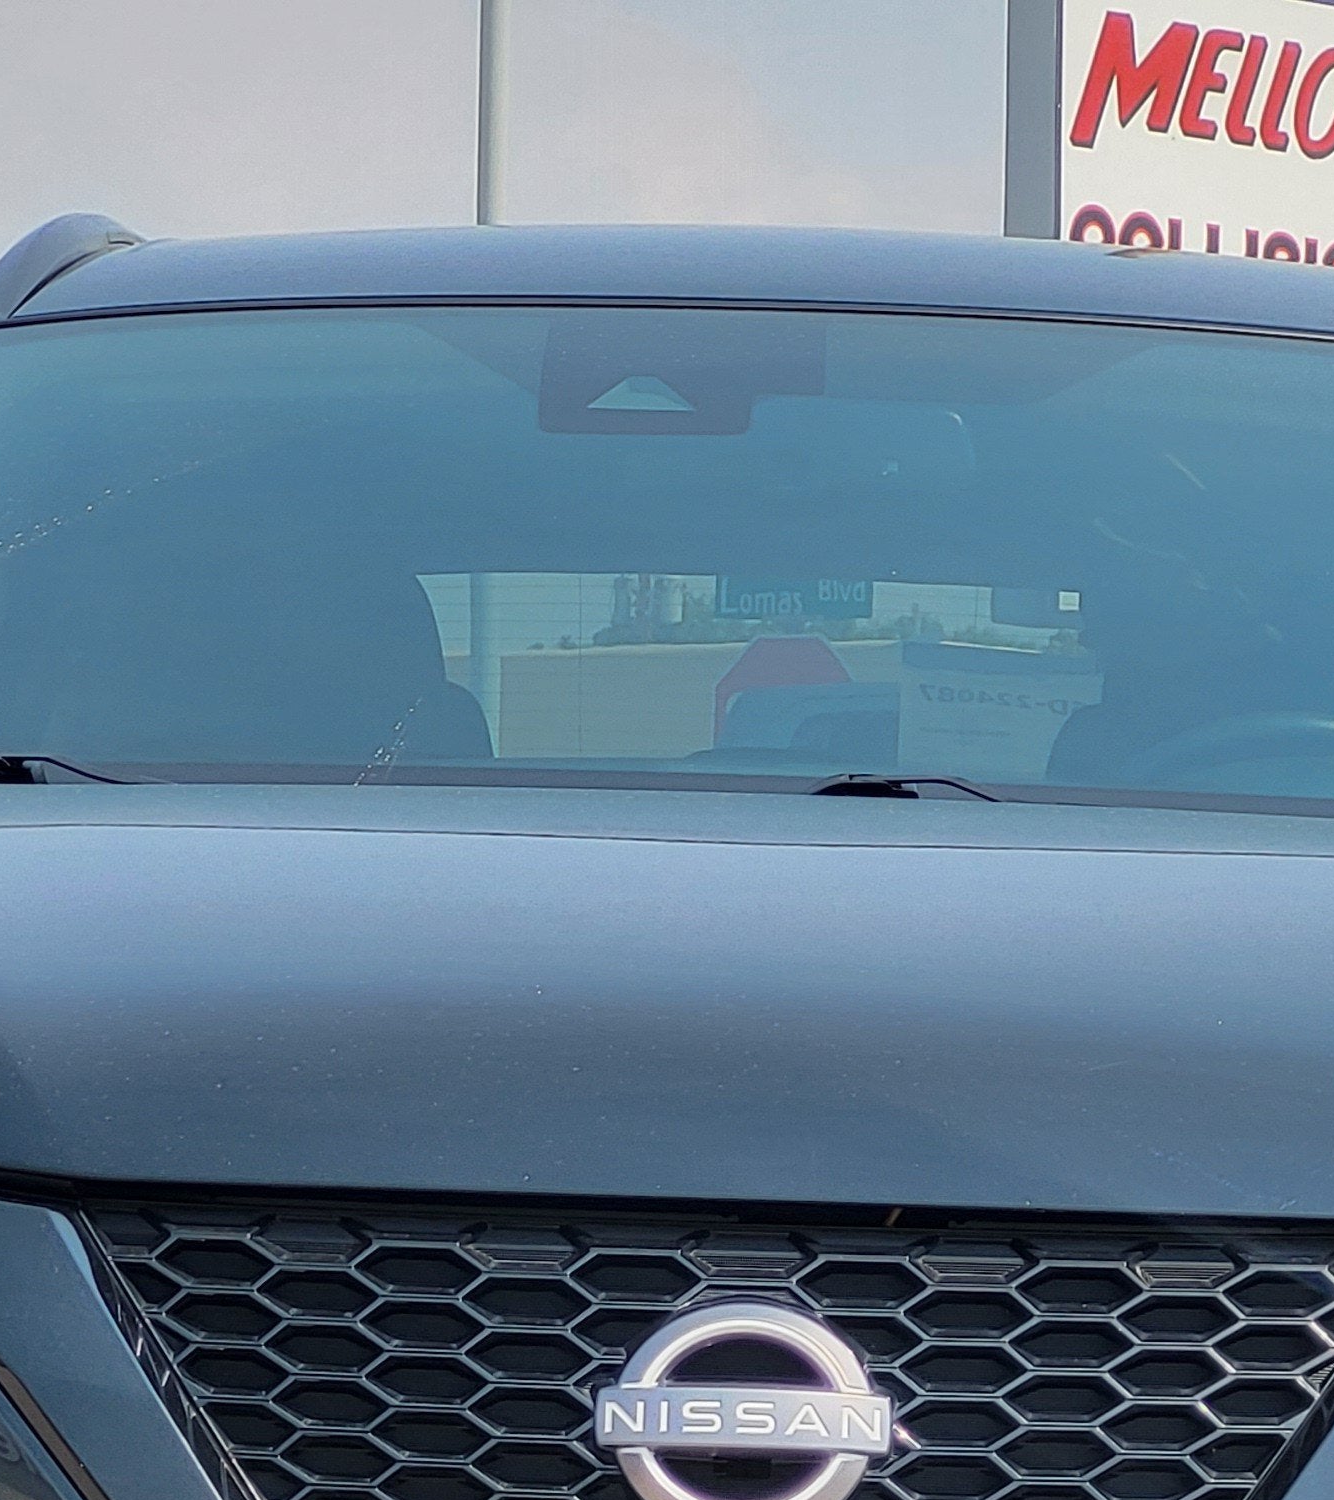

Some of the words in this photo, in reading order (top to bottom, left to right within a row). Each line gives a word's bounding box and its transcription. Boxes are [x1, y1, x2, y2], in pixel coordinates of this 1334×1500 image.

[720, 576, 803, 615] Lomas
[819, 579, 866, 602] Blvd
[603, 1400, 882, 1442] NISSAN
